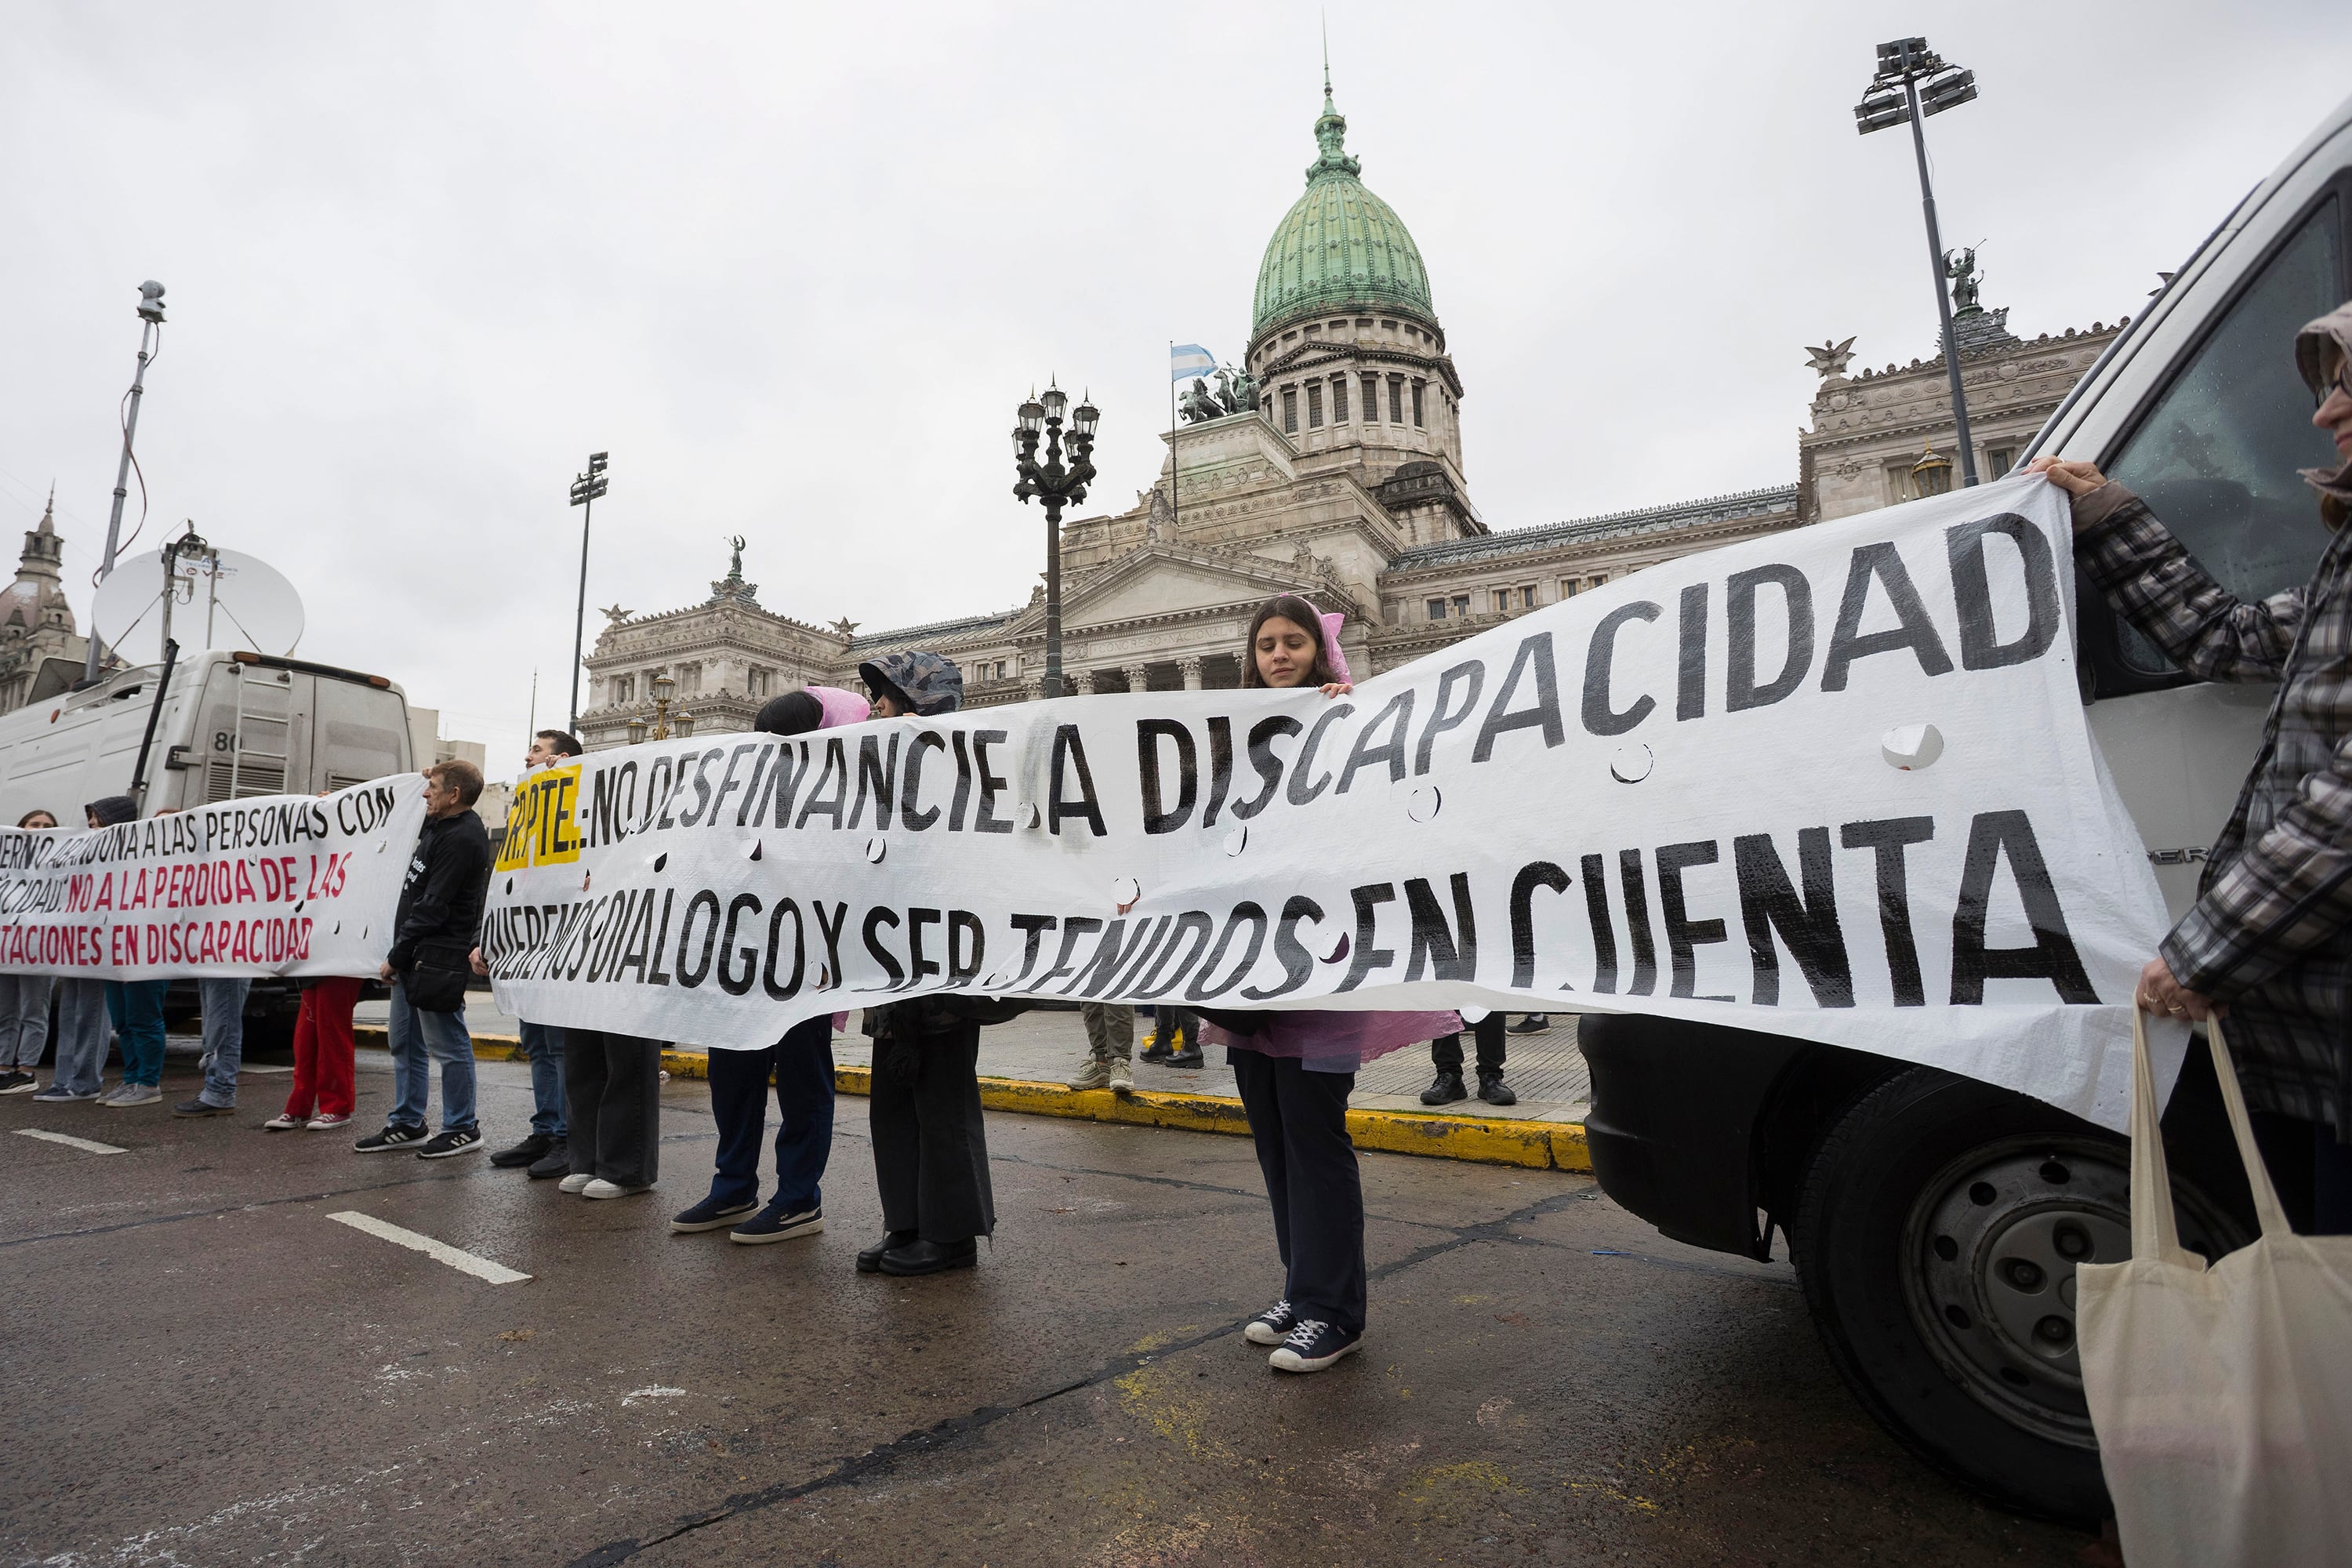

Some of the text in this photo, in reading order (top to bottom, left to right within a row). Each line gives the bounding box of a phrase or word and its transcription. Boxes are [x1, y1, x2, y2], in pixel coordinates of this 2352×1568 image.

[1099, 627, 1227, 654] CONGRESO NACIONAL
[590, 760, 637, 848] NO
[636, 729, 1014, 835] DESFINANCIE
[1049, 723, 1108, 837] A
[1137, 512, 2061, 835] DISCAPACIDAD
[214, 731, 243, 753] 80
[46, 824, 139, 869] ABANDONA
[143, 820, 156, 858] A
[162, 814, 196, 856] LAS
[205, 801, 328, 852] PERSONAS
[336, 786, 394, 837] CON
[64, 873, 94, 913] NO
[93, 872, 113, 912] A
[119, 868, 147, 911] LA
[152, 858, 256, 909] PERDIDA
[260, 856, 297, 902] DE
[307, 851, 354, 901] LAS
[2147, 846, 2210, 866] ER
[481, 895, 608, 982] QUEREMOS
[586, 887, 804, 1002] DIALOGO
[812, 899, 848, 995] Y
[981, 895, 1326, 1002] TENIDOS
[1509, 808, 2103, 1009] CUENTA
[112, 924, 139, 967] EN
[147, 916, 314, 965] DISCAPACIDAD
